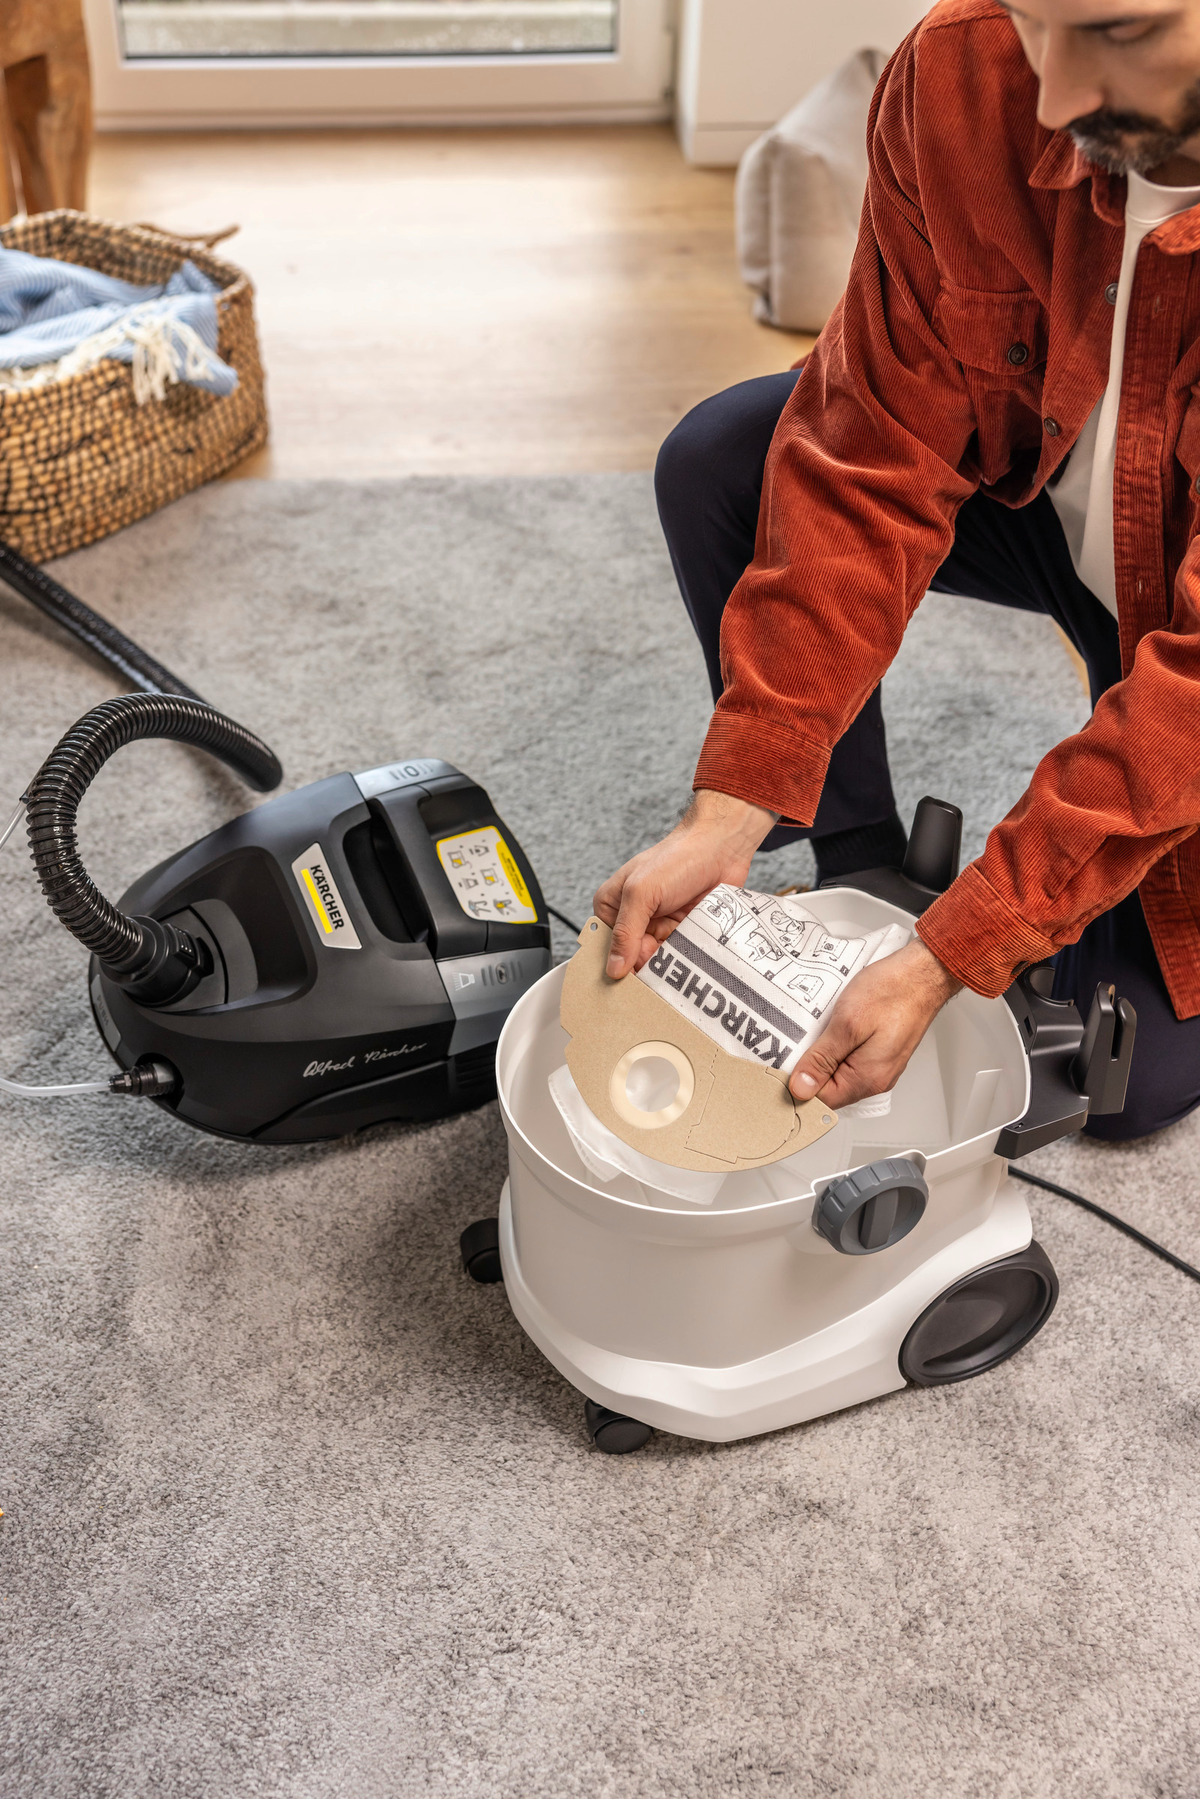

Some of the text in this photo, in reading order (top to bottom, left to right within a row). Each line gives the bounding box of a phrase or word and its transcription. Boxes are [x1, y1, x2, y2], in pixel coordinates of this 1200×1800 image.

[310, 864, 345, 930] KÄRCHER
[648, 945, 793, 1070] KÄRCHER
[302, 1056, 355, 1077] Alfred
